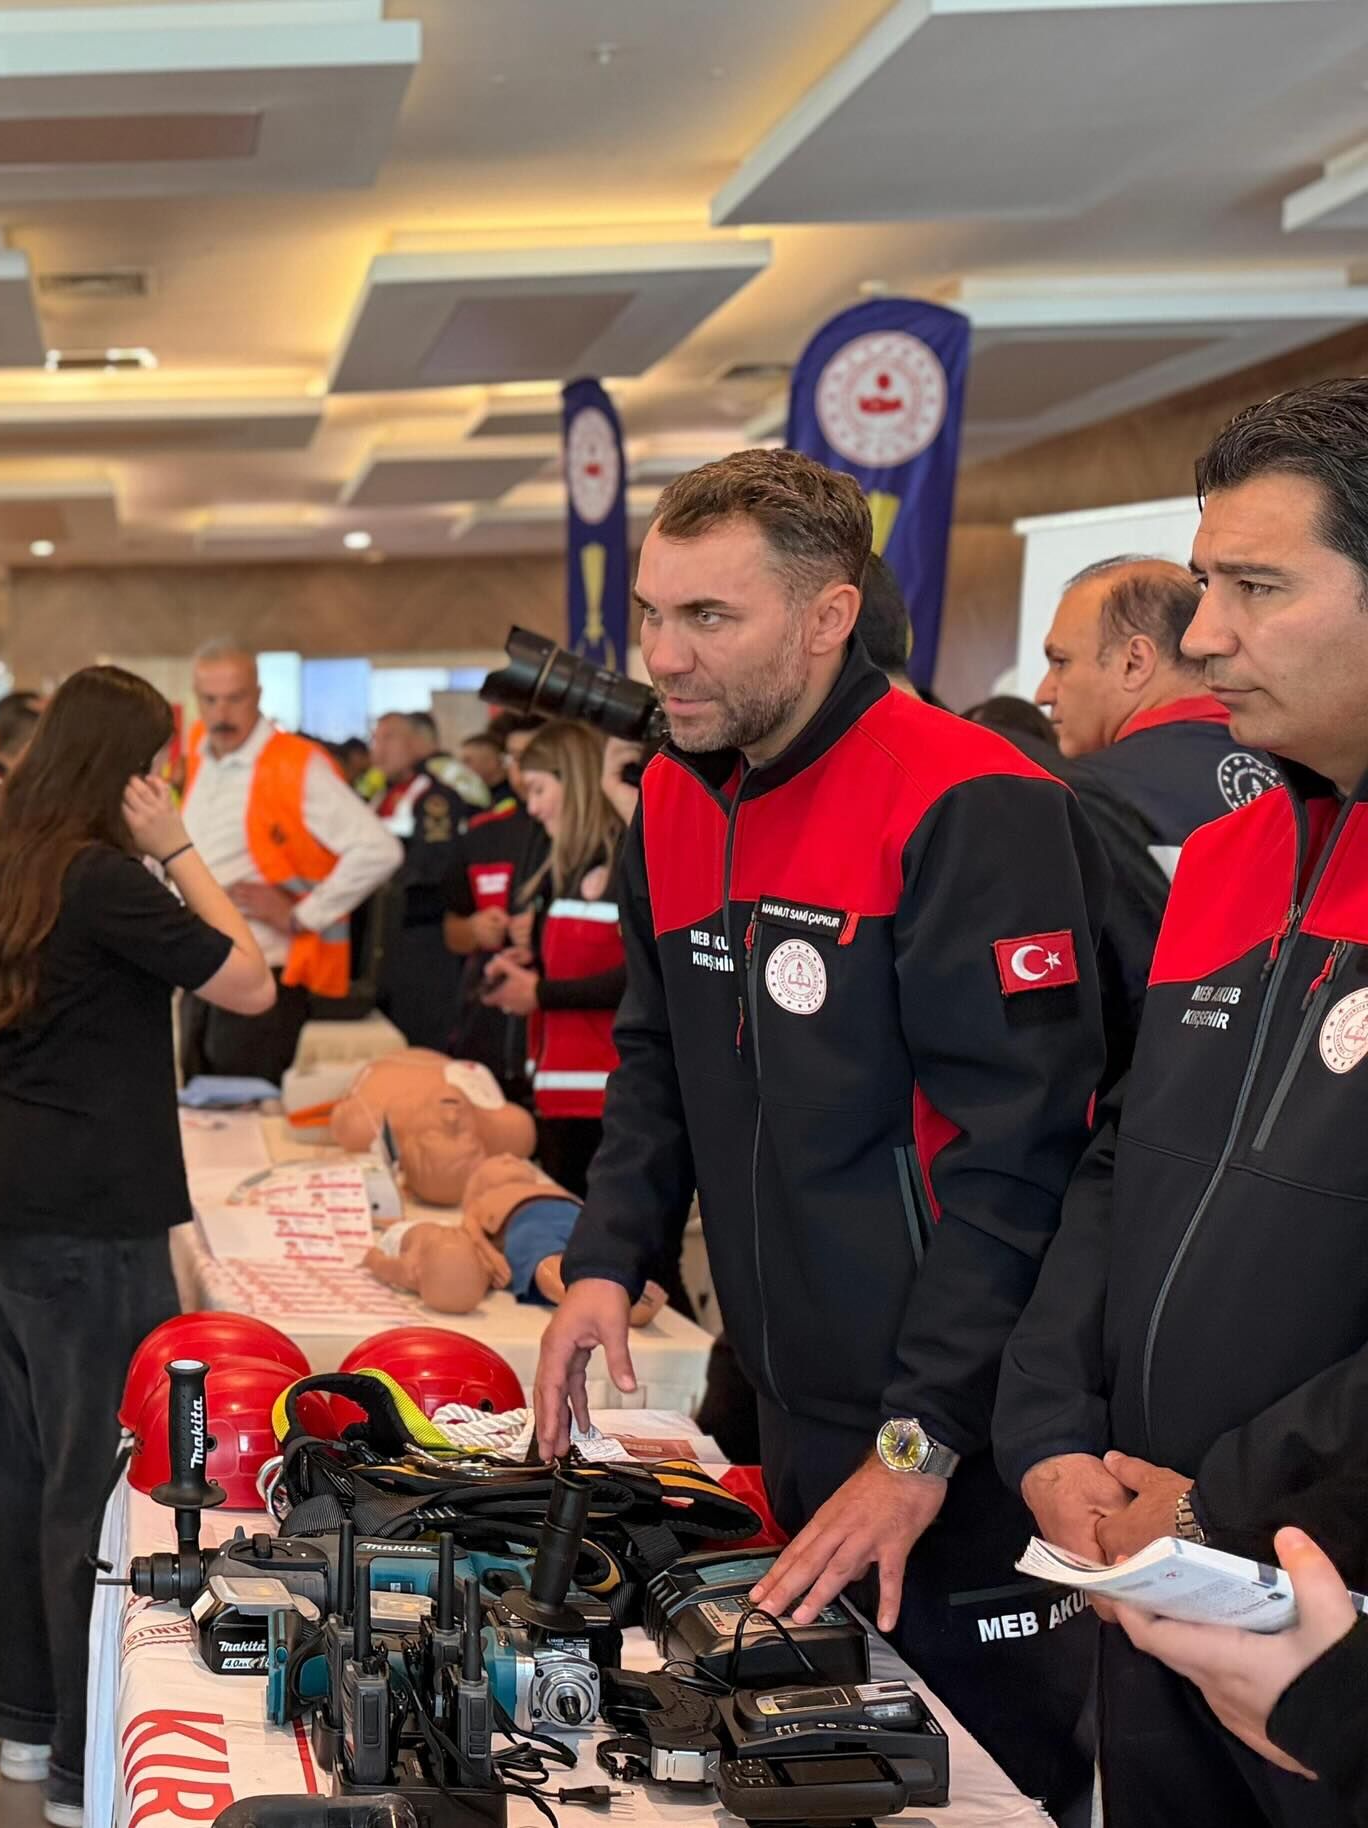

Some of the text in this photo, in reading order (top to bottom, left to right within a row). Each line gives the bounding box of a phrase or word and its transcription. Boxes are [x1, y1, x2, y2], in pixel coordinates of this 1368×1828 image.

[690, 929, 710, 947] MEB
[1191, 985, 1241, 1005] MEB AKUB
[977, 1611, 1039, 1643] MEB
